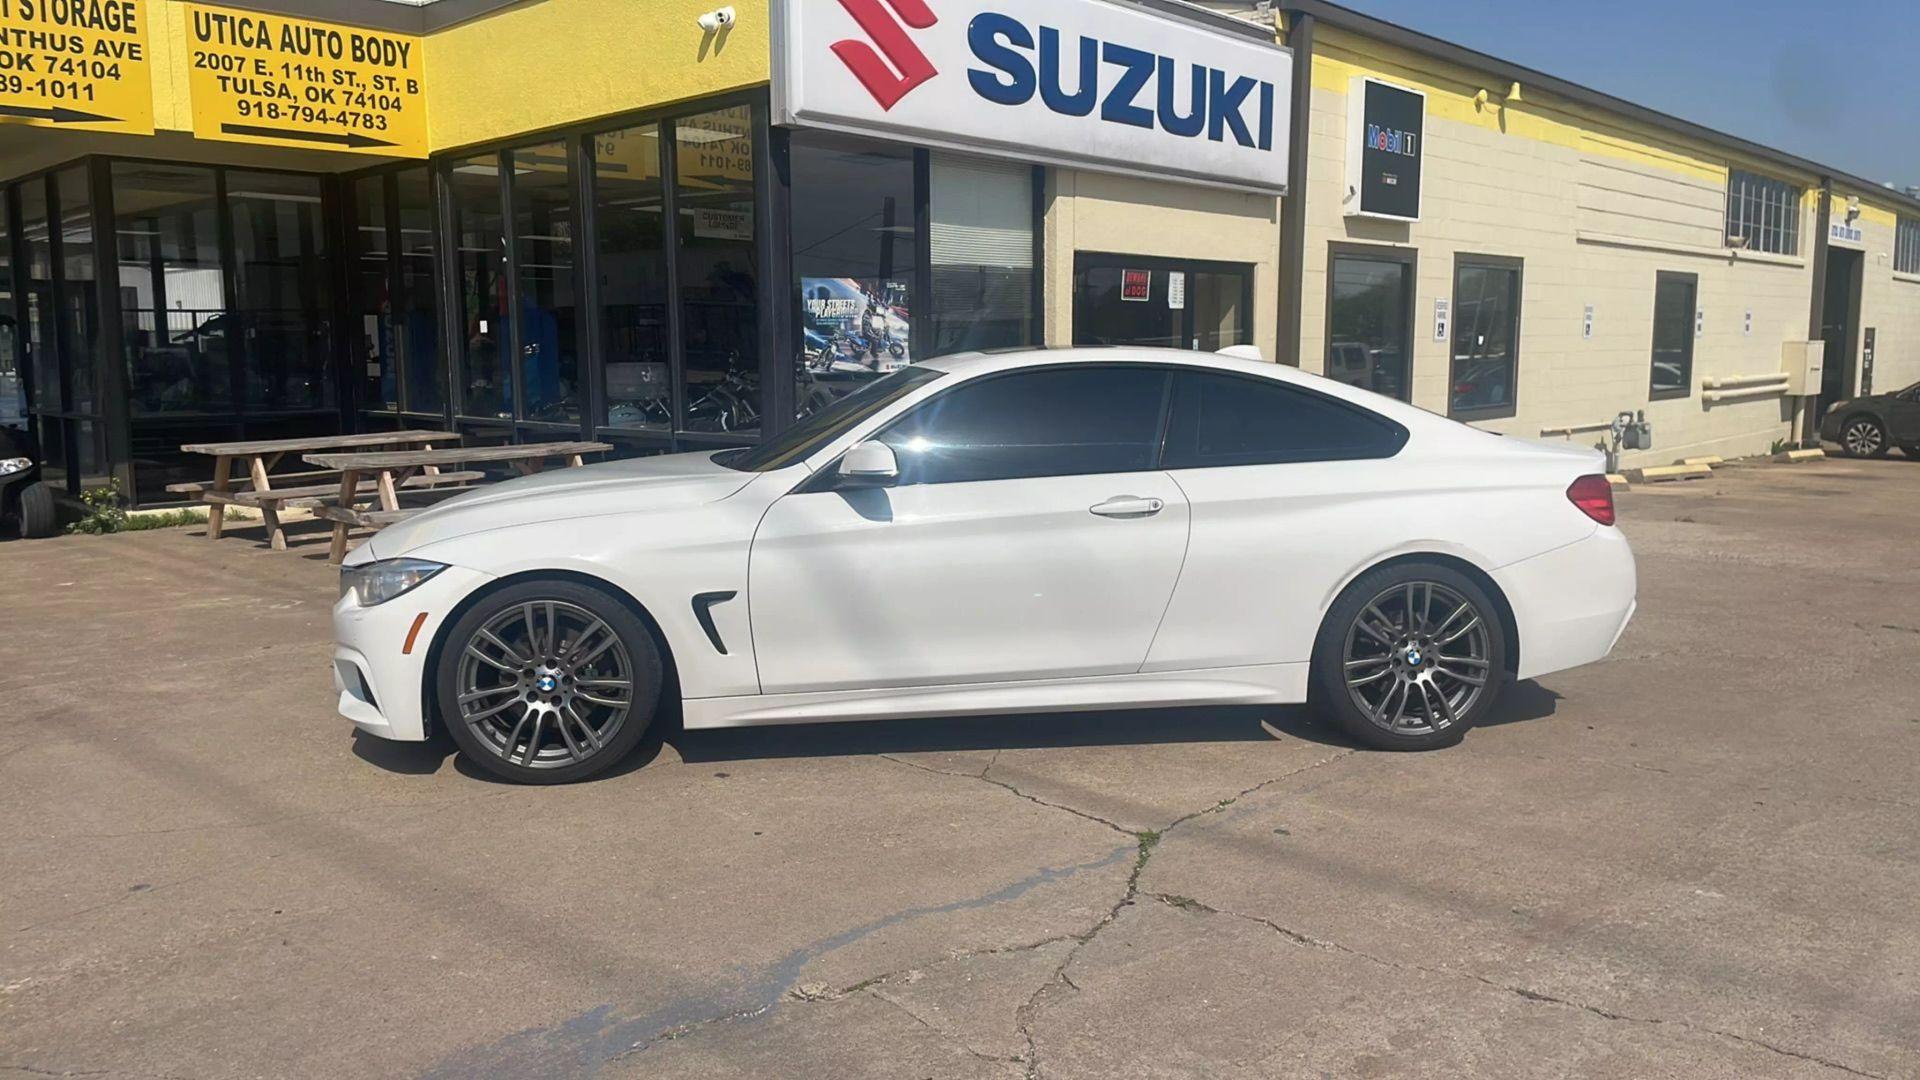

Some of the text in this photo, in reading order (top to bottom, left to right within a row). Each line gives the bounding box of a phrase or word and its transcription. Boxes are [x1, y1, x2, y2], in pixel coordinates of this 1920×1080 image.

[93, 39, 143, 61] AVE
[194, 11, 411, 69] UTICA AUTO BODY
[0, 51, 121, 81] OK 74104
[194, 51, 246, 72] 2007
[255, 59, 273, 77] E.
[281, 62, 325, 83] 11th
[373, 75, 400, 92] ST.
[407, 79, 419, 94] B
[967, 12, 1274, 151] SUZUKI
[217, 75, 402, 112] TULSA, OK 74104
[238, 100, 387, 130] 918-794-4783
[1367, 123, 1402, 154] Mobil
[807, 299, 826, 311] YOUR
